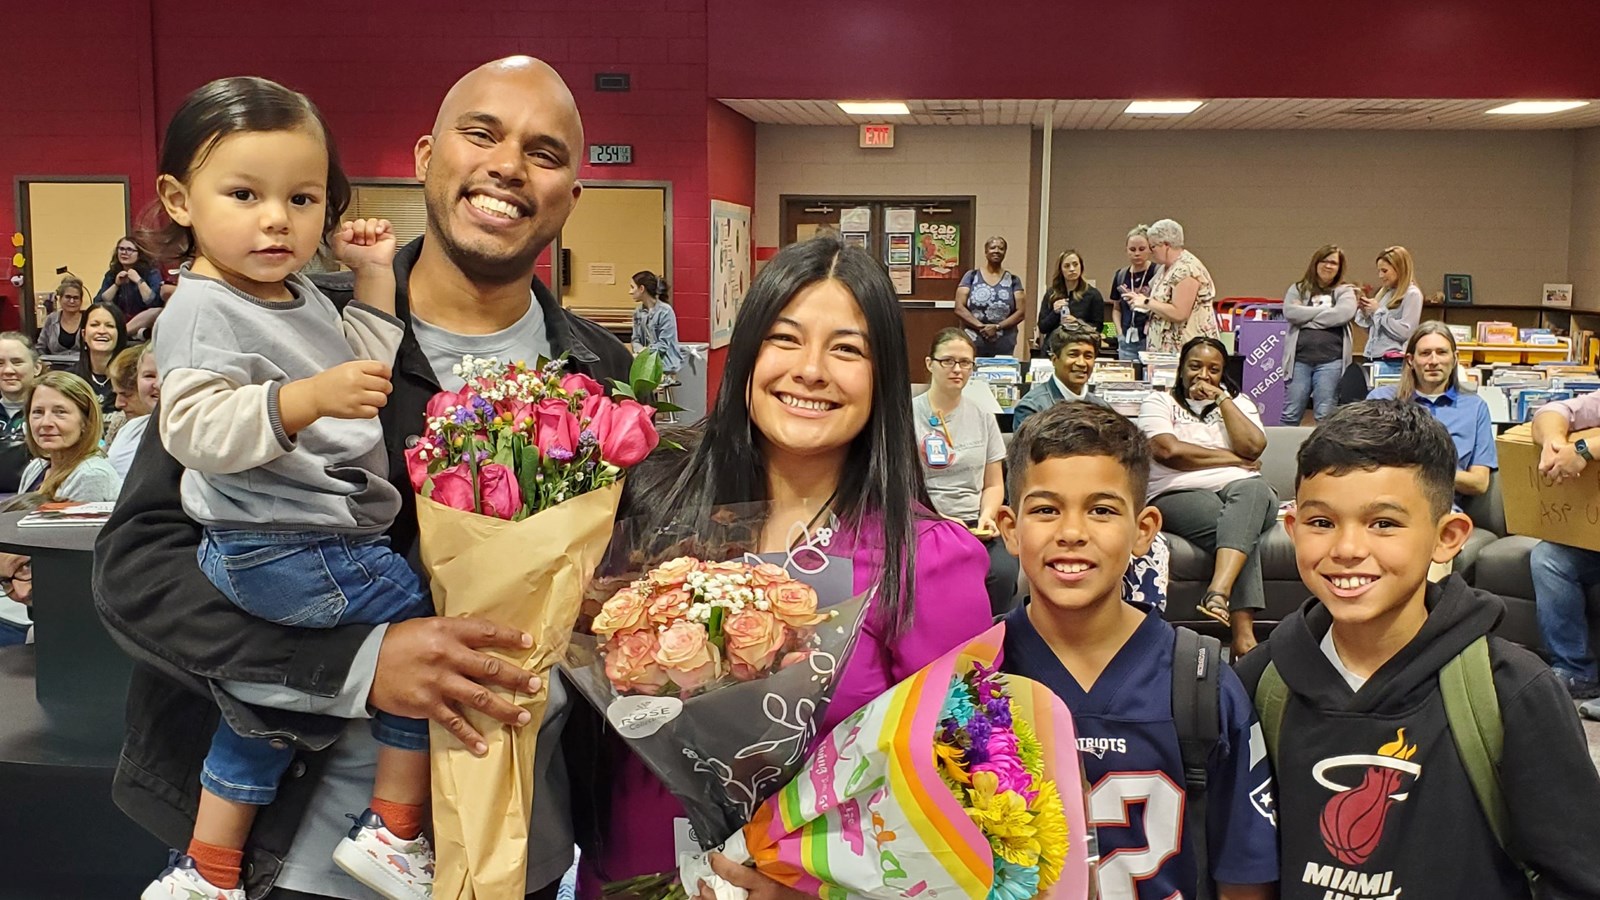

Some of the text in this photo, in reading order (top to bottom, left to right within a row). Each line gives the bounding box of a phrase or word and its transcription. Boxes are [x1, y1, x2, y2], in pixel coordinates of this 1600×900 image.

[865, 126, 889, 145] EXIT
[1245, 334, 1280, 366] UBER
[1250, 366, 1284, 398] READS
[621, 707, 671, 727] ROSE
[1075, 737, 1126, 754] TRIOTS
[1302, 861, 1394, 896] MIAMI
